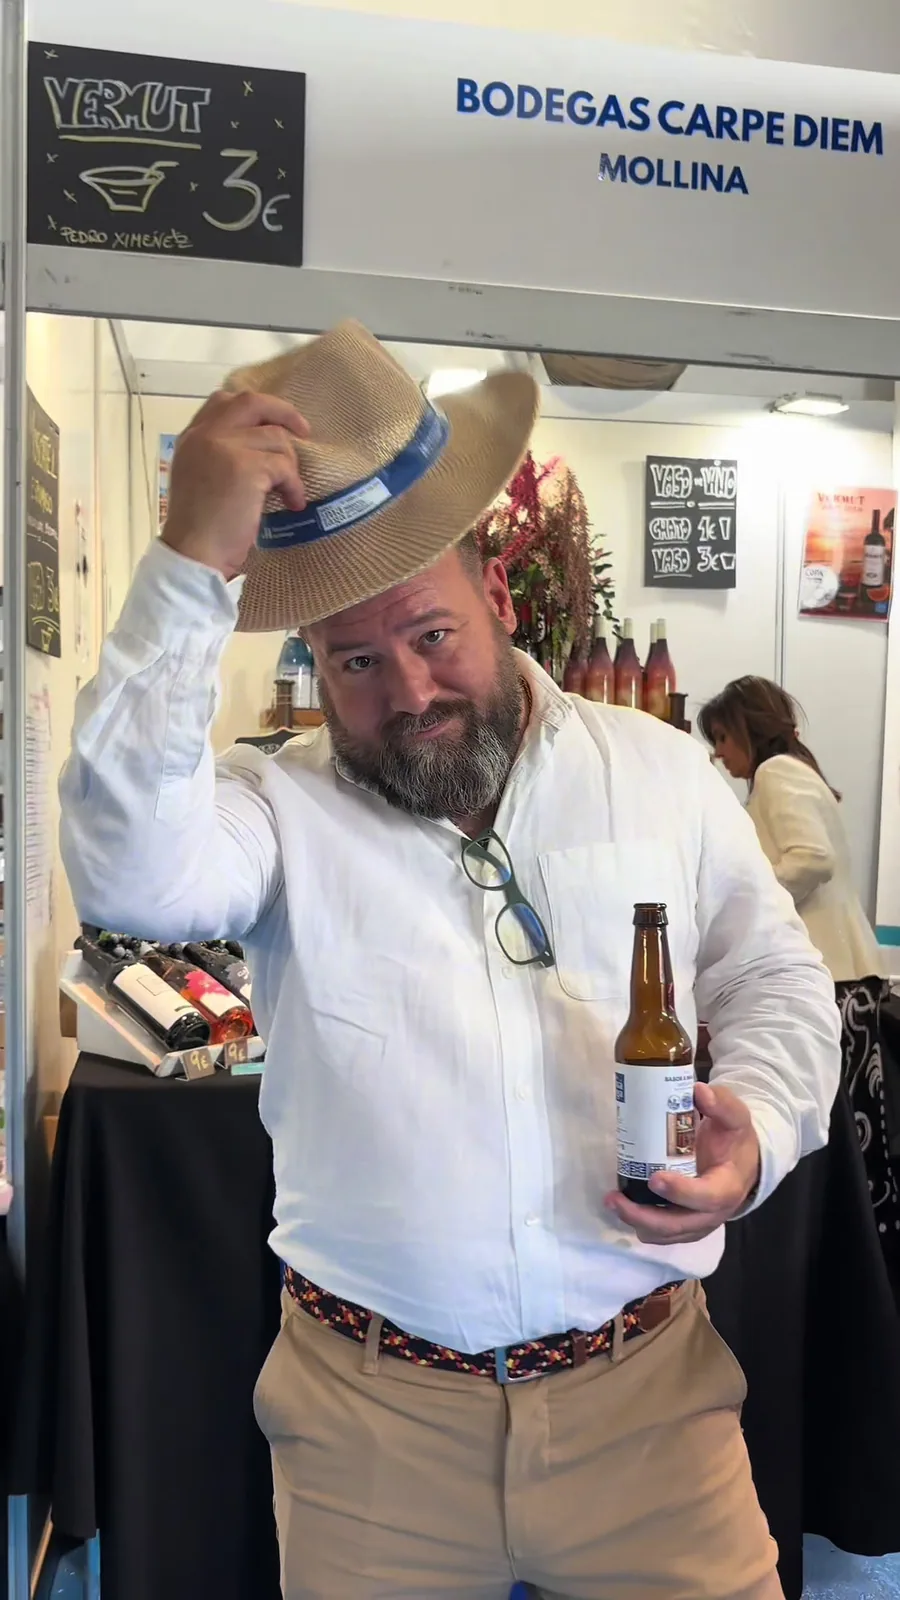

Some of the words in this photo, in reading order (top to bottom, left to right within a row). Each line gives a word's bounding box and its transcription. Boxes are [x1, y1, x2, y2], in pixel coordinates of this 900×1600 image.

[43, 76, 212, 132] VERMUT
[456, 77, 651, 132] BODEGAS
[657, 100, 785, 146] CARPE
[792, 113, 884, 155] DIEM
[202, 148, 291, 231] 3€
[598, 152, 749, 195] MOLLINA
[60, 226, 108, 243] PEDRO
